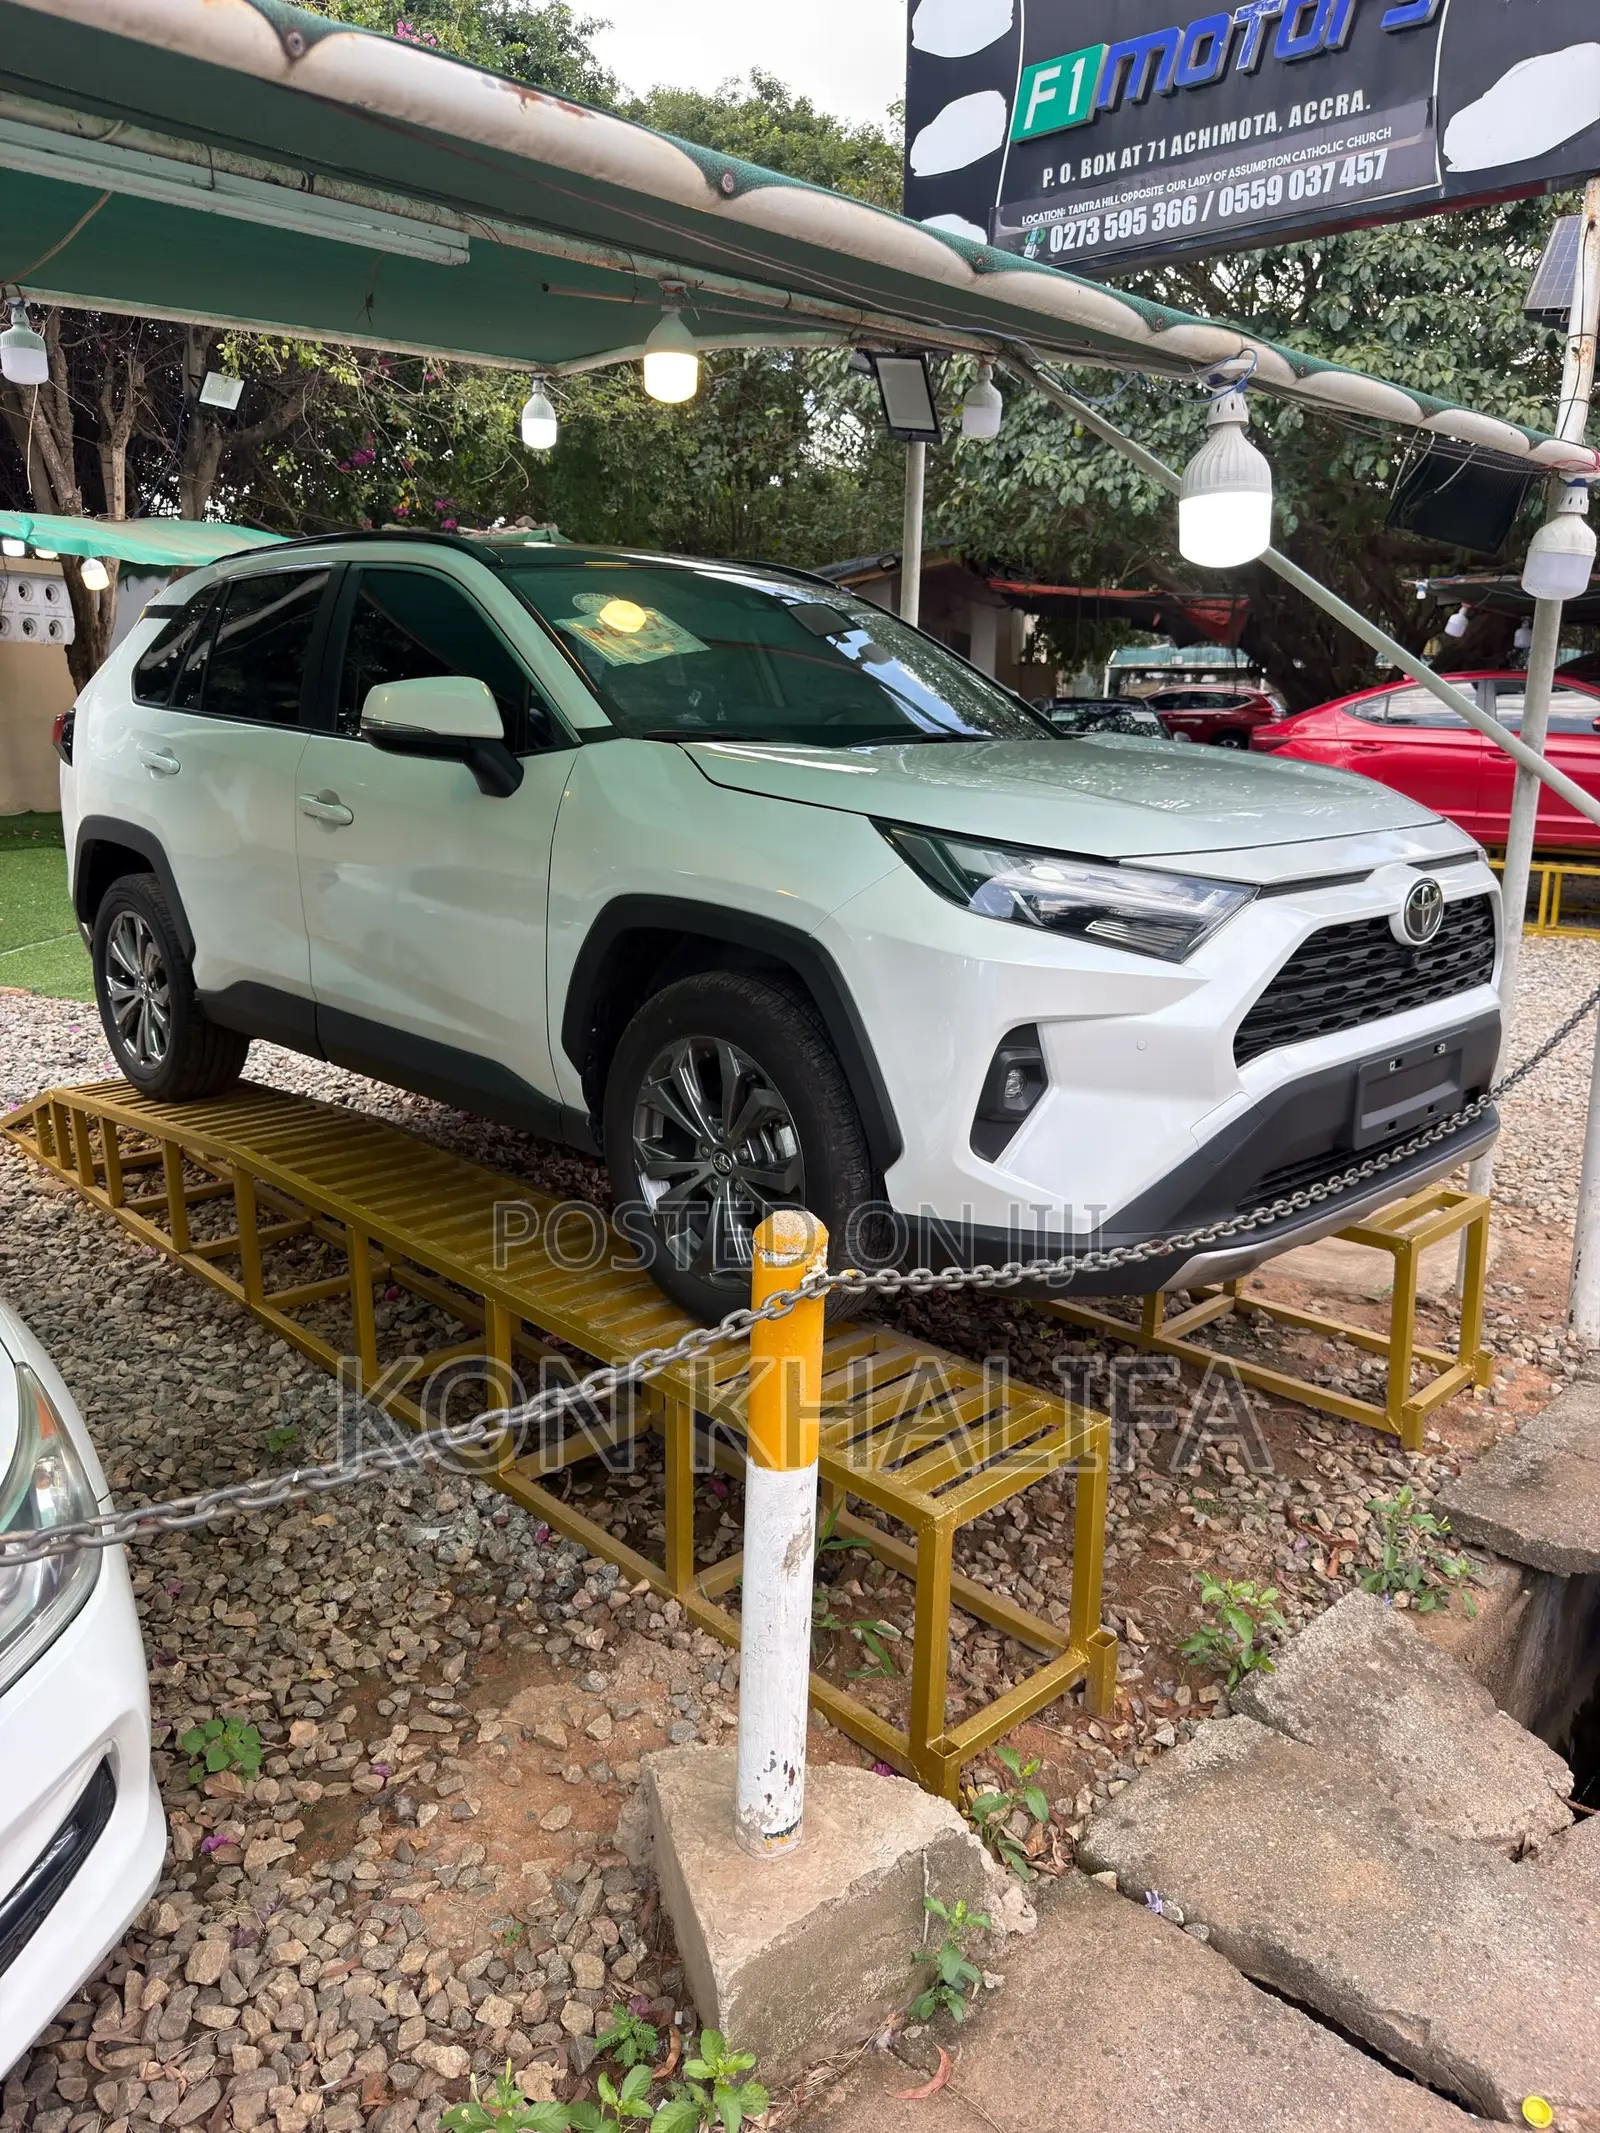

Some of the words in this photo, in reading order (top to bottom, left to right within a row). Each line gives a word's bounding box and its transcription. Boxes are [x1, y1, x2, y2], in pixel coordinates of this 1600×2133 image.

[1023, 57, 1087, 131] F1
[1042, 167, 1056, 188] P.
[1060, 163, 1076, 184] O.
[1080, 151, 1117, 180] BOX
[1119, 144, 1143, 169] AT
[1147, 138, 1166, 162] 71
[1170, 111, 1283, 157] ACHIMOTA,
[1288, 89, 1371, 128] ACCRA.
[1021, 206, 1067, 226] LOCATION:
[1067, 200, 1101, 215] TANTRA
[1101, 193, 1121, 208] HILL
[1120, 184, 1164, 203] OPPOSITE
[1166, 179, 1187, 193] OUR
[1187, 172, 1212, 188] LADY
[1213, 169, 1228, 182] OF
[1228, 153, 1291, 179] ASSUMPTION
[1292, 139, 1344, 163] CATHOLIC
[1346, 126, 1392, 148] CHURCH
[1050, 216, 1101, 253] 0273
[1103, 205, 1148, 242] 595
[1151, 195, 1198, 232] 366
[1200, 190, 1215, 222] /
[1218, 174, 1283, 218] 0559
[1288, 161, 1336, 201] 037
[1339, 147, 1389, 187] 457
